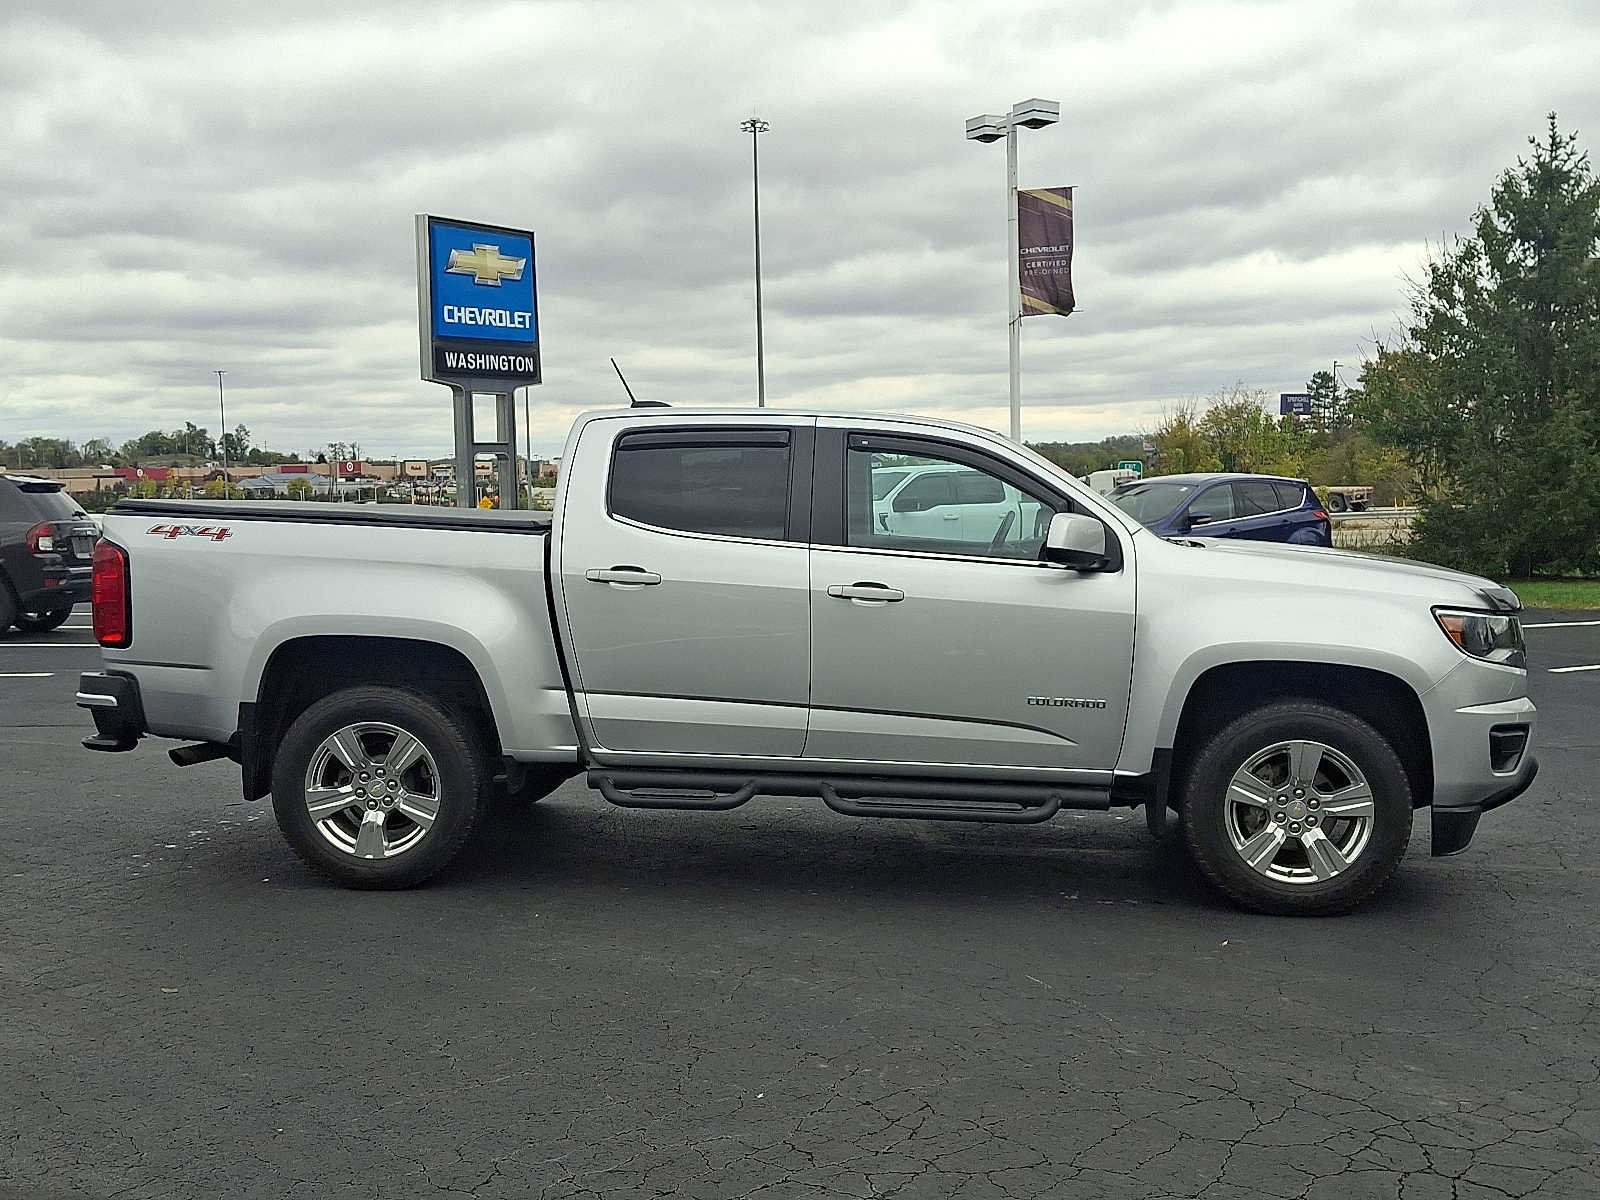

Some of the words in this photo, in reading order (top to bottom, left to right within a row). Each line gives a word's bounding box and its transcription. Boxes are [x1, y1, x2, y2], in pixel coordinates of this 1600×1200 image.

[1020, 245, 1070, 254] CHEVROLET
[1026, 260, 1067, 268] CERTIFIED
[443, 305, 532, 329] CHEVROLET
[445, 352, 534, 372] WASHINGTON
[1027, 696, 1107, 709] COLORADO
